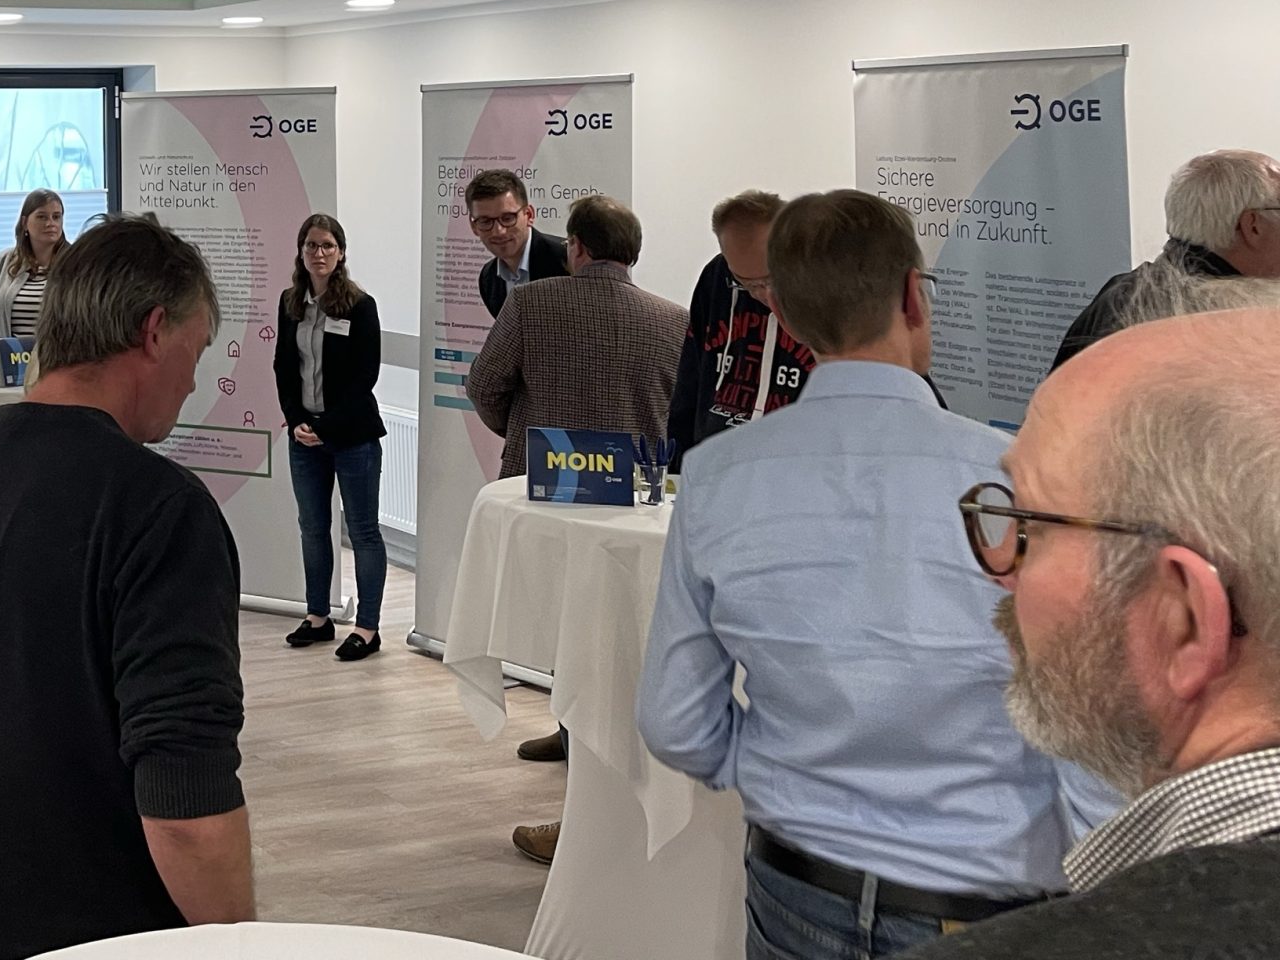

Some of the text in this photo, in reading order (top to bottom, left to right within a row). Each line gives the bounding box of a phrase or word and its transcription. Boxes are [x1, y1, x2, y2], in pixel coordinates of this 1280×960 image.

[1049, 99, 1101, 123] OGE
[278, 119, 317, 133] OGE
[573, 113, 613, 130] OGE
[139, 163, 269, 176] Wir stellen Mensch
[877, 167, 935, 187] Sichere
[139, 179, 256, 192] und Natur in den
[529, 185, 545, 199] im
[139, 195, 219, 209] Mittelpunkt.
[917, 218, 1053, 245] und in Zukunft.
[10, 352, 32, 365] MO
[717, 353, 734, 373] 19
[776, 365, 800, 388] 63
[547, 451, 614, 473] MOIN
